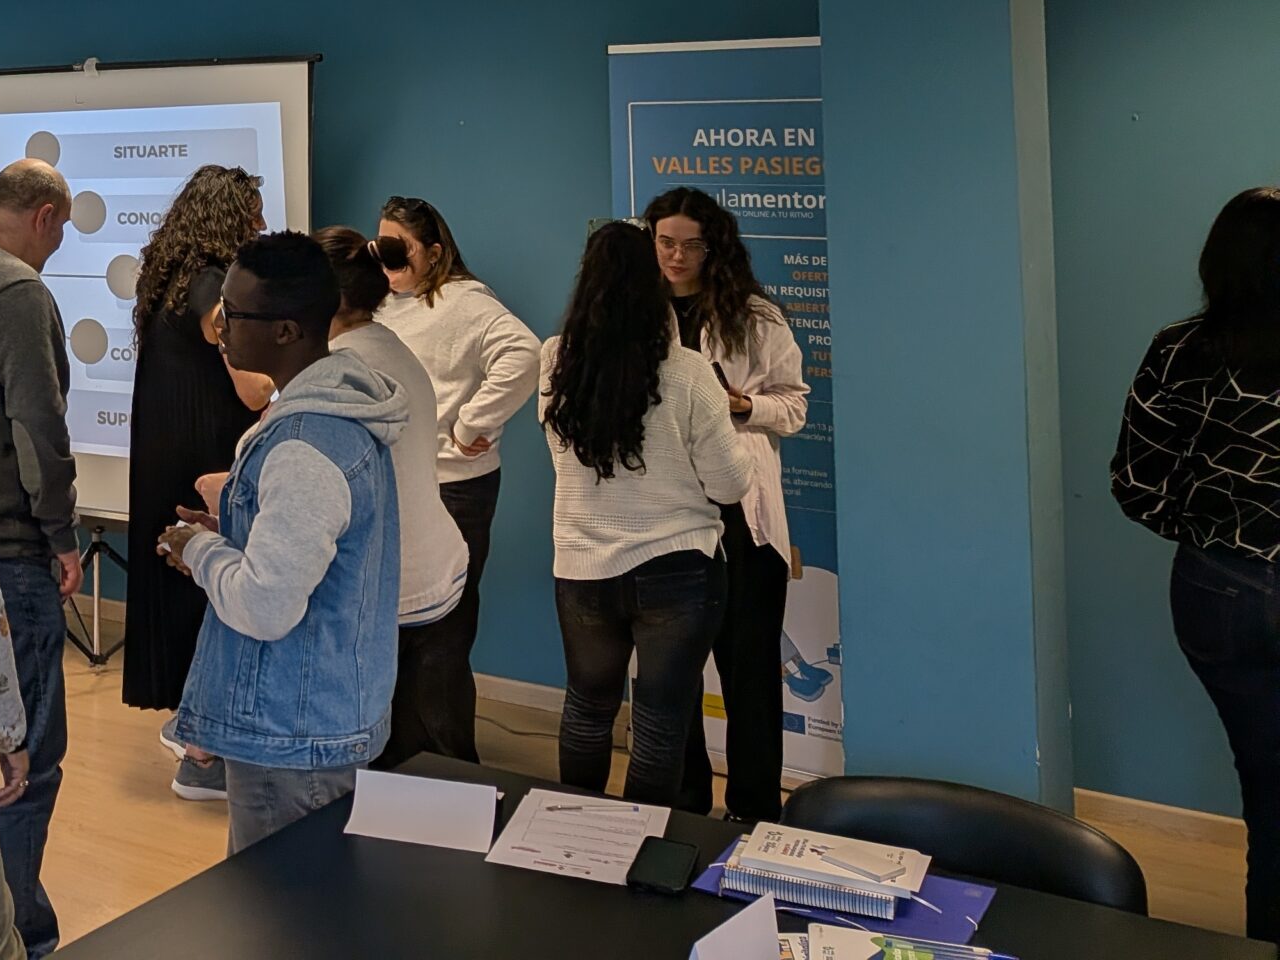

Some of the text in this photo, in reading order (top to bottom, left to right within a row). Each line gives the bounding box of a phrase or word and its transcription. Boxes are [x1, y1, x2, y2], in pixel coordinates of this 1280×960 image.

[693, 128, 815, 147] AHORA EN
[113, 144, 188, 159] SITUARTE
[653, 157, 826, 176] VALLES PASIEG
[783, 253, 827, 266] MÁS DE
[786, 303, 830, 313] ABIERT
[808, 335, 832, 346] PRO
